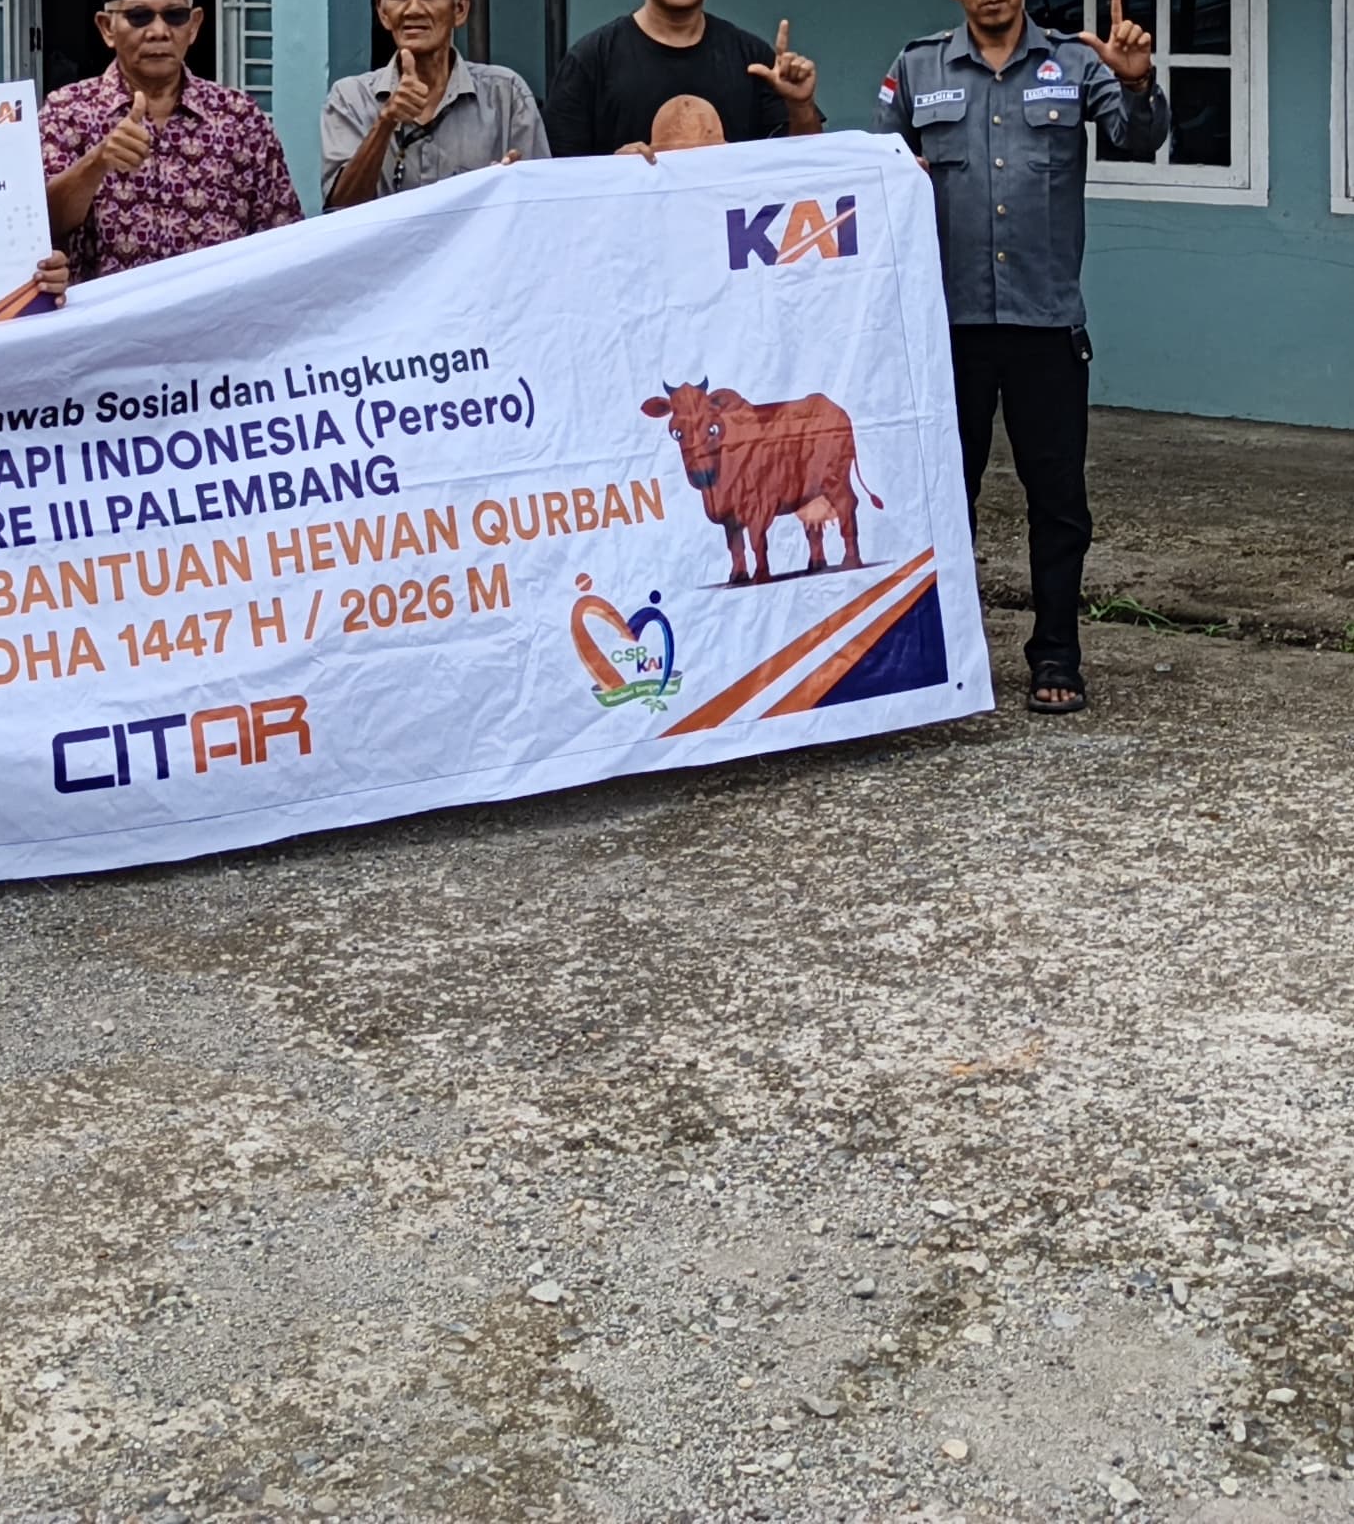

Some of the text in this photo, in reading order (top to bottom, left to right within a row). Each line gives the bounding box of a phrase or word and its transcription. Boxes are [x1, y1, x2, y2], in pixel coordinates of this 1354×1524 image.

[725, 194, 859, 271] KAI
[95, 378, 200, 423] Sosial
[209, 372, 276, 411] dan
[284, 342, 491, 404] Lingkungan
[80, 409, 345, 484] INDONESIA
[354, 378, 538, 449] (Persero)
[49, 498, 94, 543] III
[107, 453, 401, 534] PALEMBANG
[266, 506, 461, 577] HEWAN
[471, 476, 665, 548] QURBAN
[117, 608, 235, 668] 1447
[248, 597, 287, 648] H
[303, 588, 324, 642] /
[342, 573, 455, 634] 2026
[467, 562, 513, 612] M
[611, 646, 648, 664] CSR
[636, 656, 663, 673] KAI
[52, 694, 312, 795] CITAR
